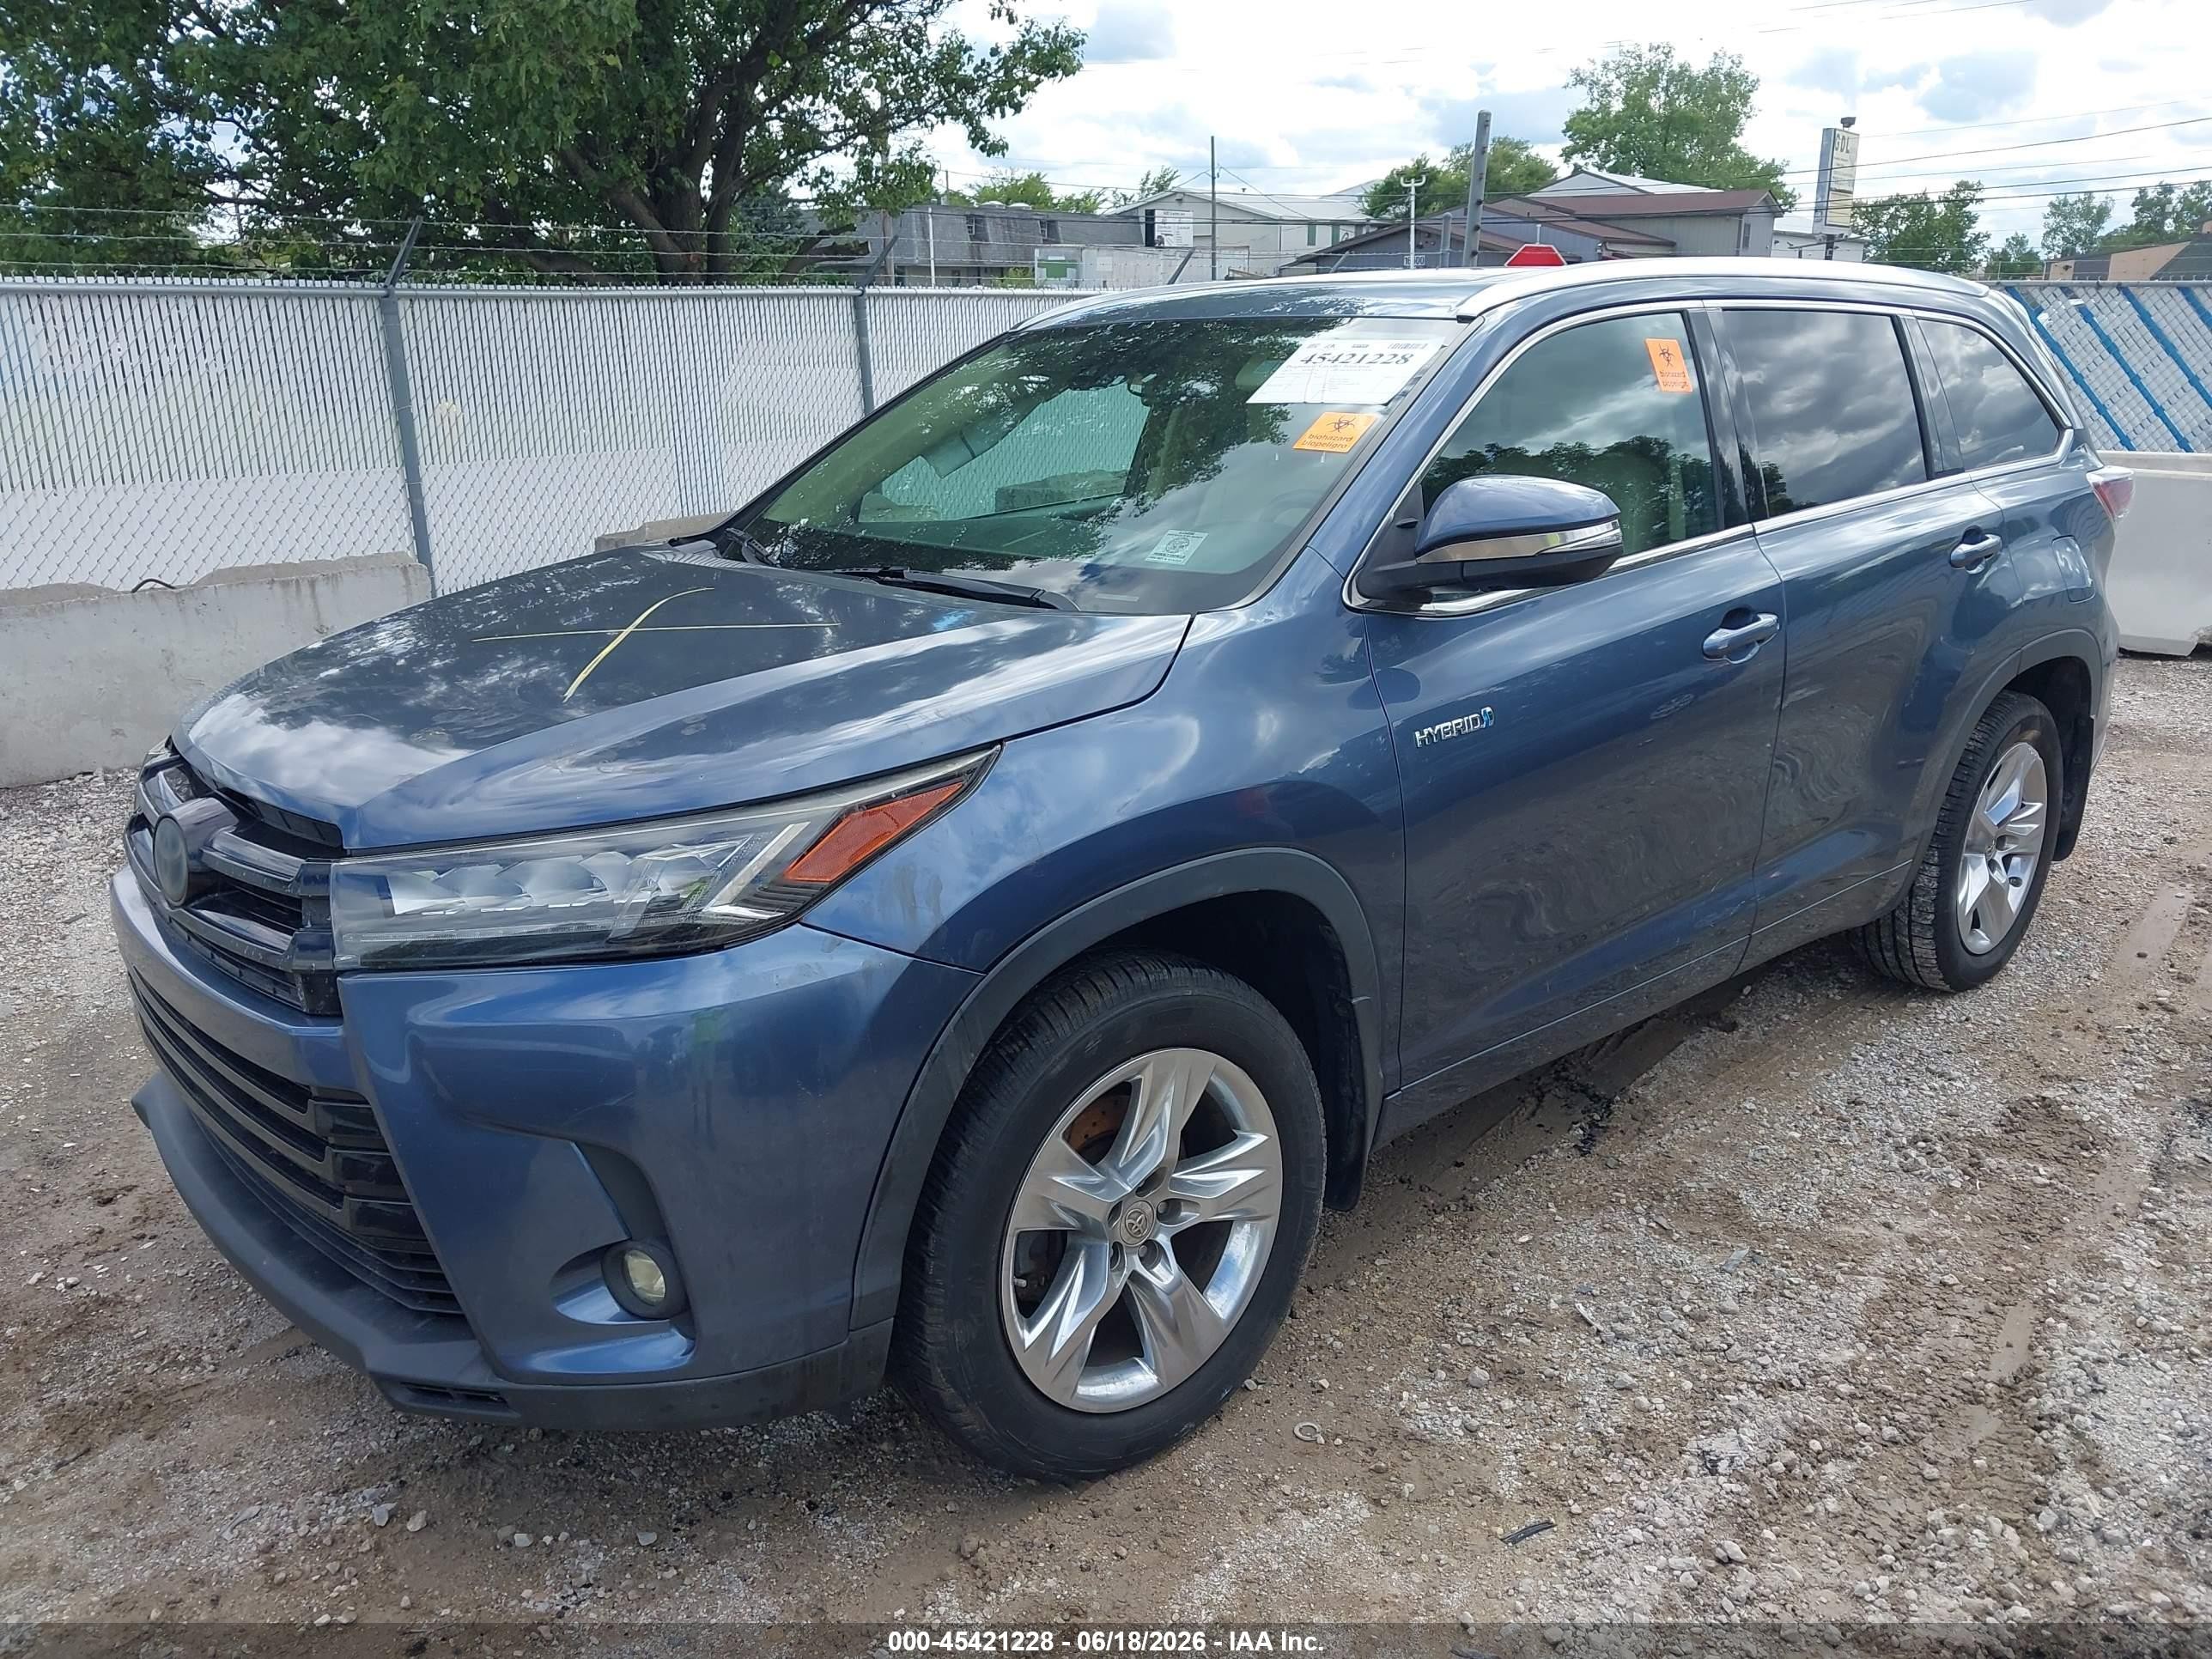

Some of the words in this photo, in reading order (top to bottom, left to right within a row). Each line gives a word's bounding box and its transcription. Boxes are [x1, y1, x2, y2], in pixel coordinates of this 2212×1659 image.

[1300, 352, 1414, 365] 45421228
[1301, 440, 1347, 450] biopeligro
[1414, 714, 1481, 748] HYBRID
